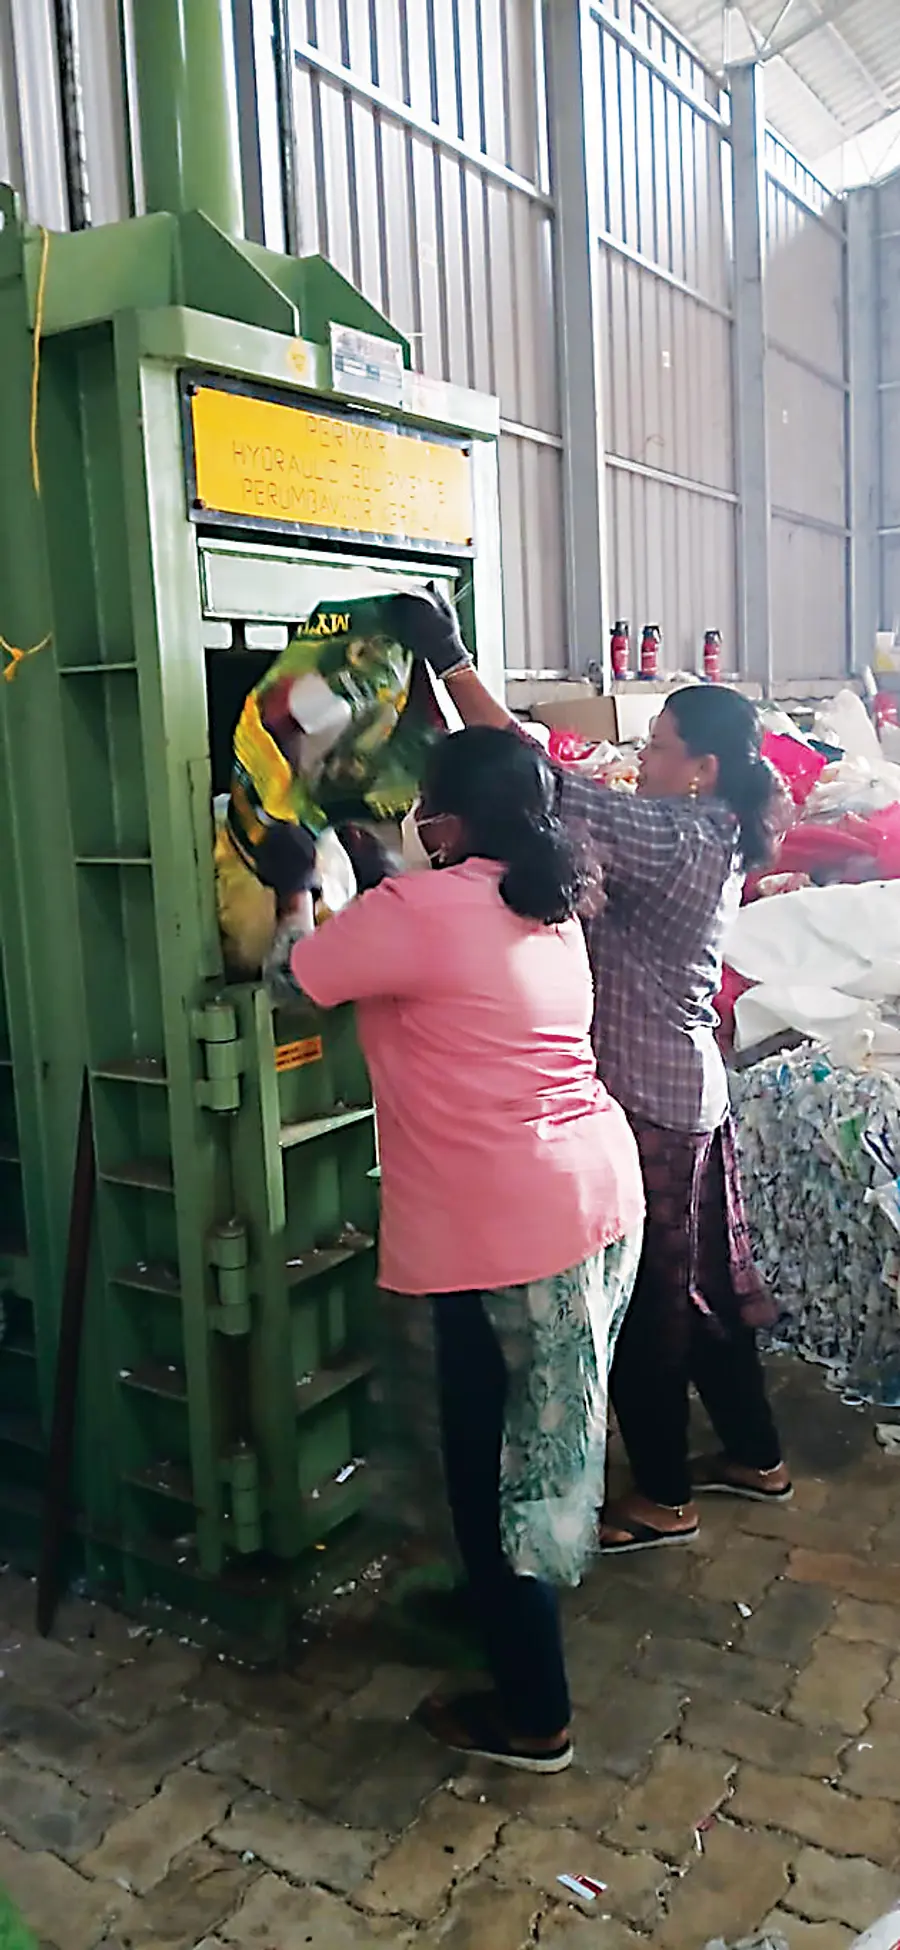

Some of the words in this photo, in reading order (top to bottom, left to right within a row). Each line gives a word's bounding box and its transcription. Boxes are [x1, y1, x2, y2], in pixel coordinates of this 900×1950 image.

[306, 415, 385, 457] PERIYAR
[232, 440, 339, 484] HYDRAULC
[351, 463, 446, 505] EQUPMES
[380, 502, 443, 533] ERL
